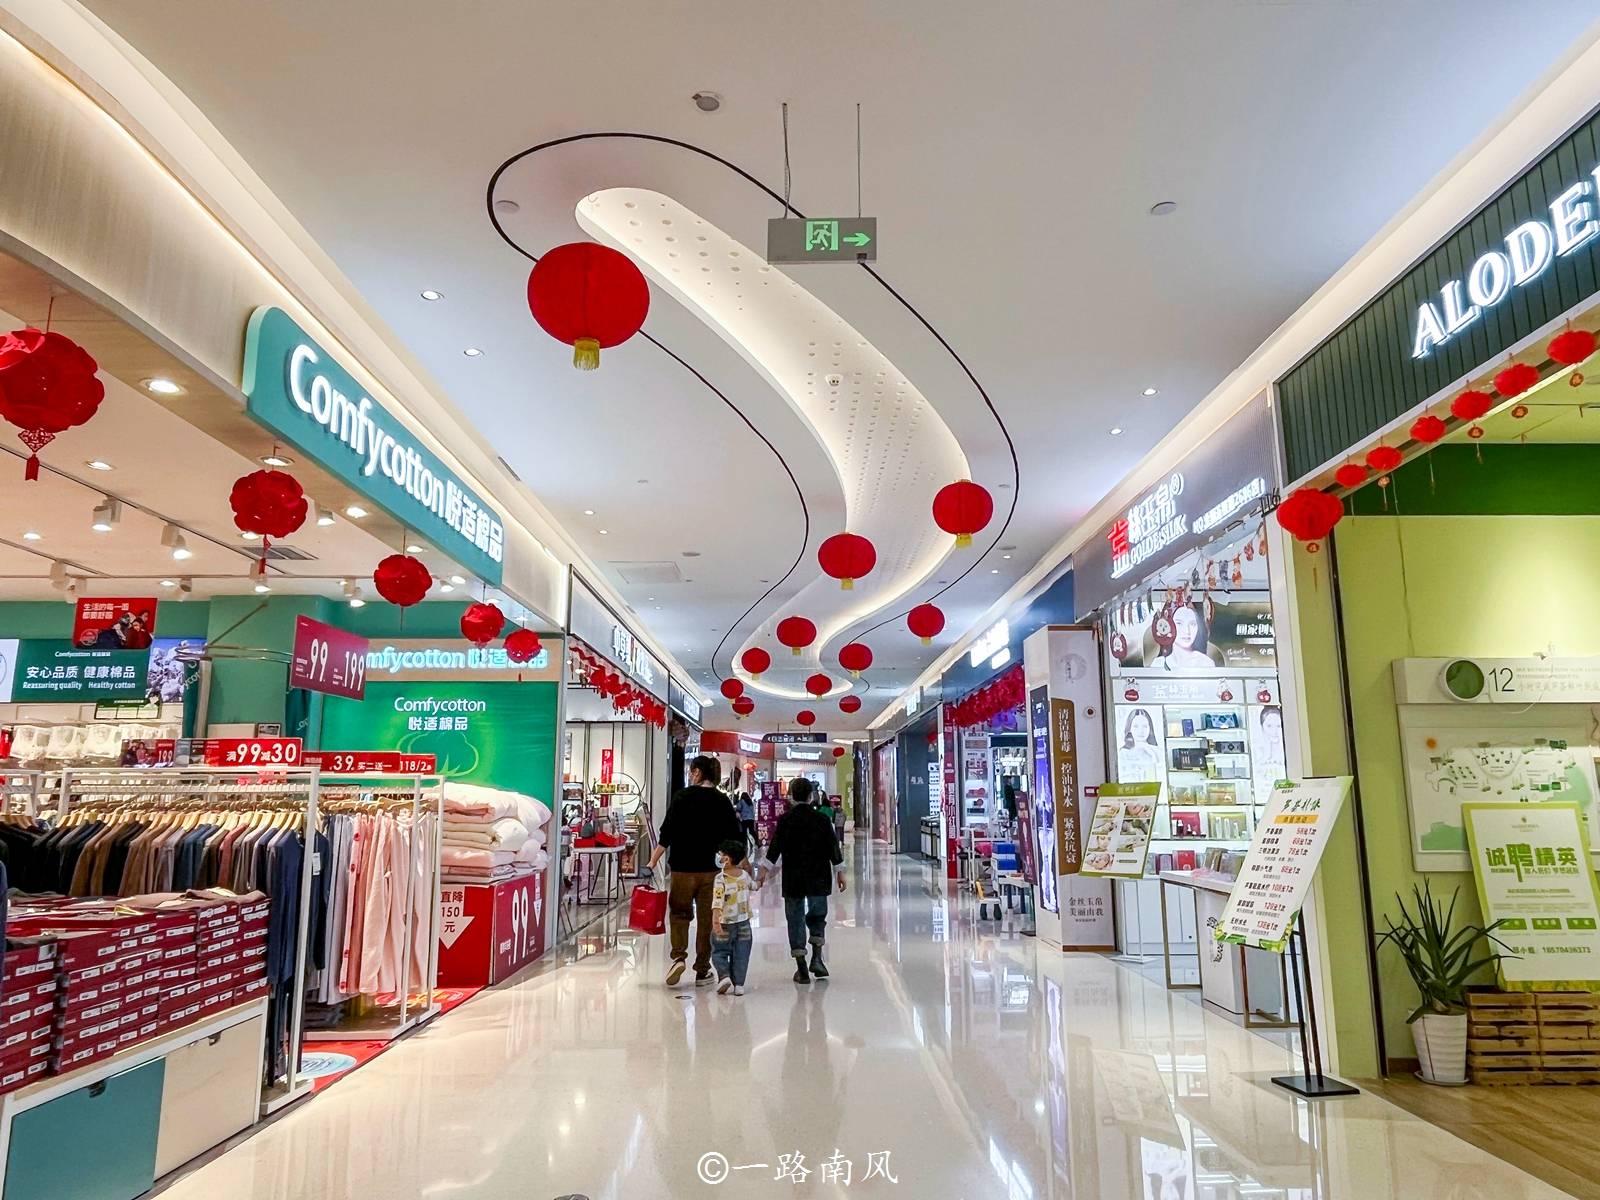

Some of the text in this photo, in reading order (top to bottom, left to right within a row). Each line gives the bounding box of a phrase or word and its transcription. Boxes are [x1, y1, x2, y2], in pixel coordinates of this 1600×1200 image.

[290, 344, 449, 518] Comfycotton
[26, 666, 136, 679] 安心品质 健康棉品
[310, 638, 328, 682] 99
[345, 651, 365, 691] 199
[366, 646, 548, 673] mfycotton 悦适品
[22, 681, 58, 690] Reassuring
[59, 682, 82, 690] quality
[88, 681, 113, 690] Healthy
[1488, 667, 1516, 692] 12
[394, 696, 487, 716] Comfycotton
[357, 762, 393, 771] 买二送一
[1061, 762, 1073, 808] 控油补水
[1063, 817, 1076, 864] 紧致抗衰
[1486, 843, 1577, 882] 诚聘精英
[439, 891, 463, 903] 直降
[441, 906, 460, 917] 150
[444, 921, 456, 932] 元
[511, 886, 528, 965] 99
